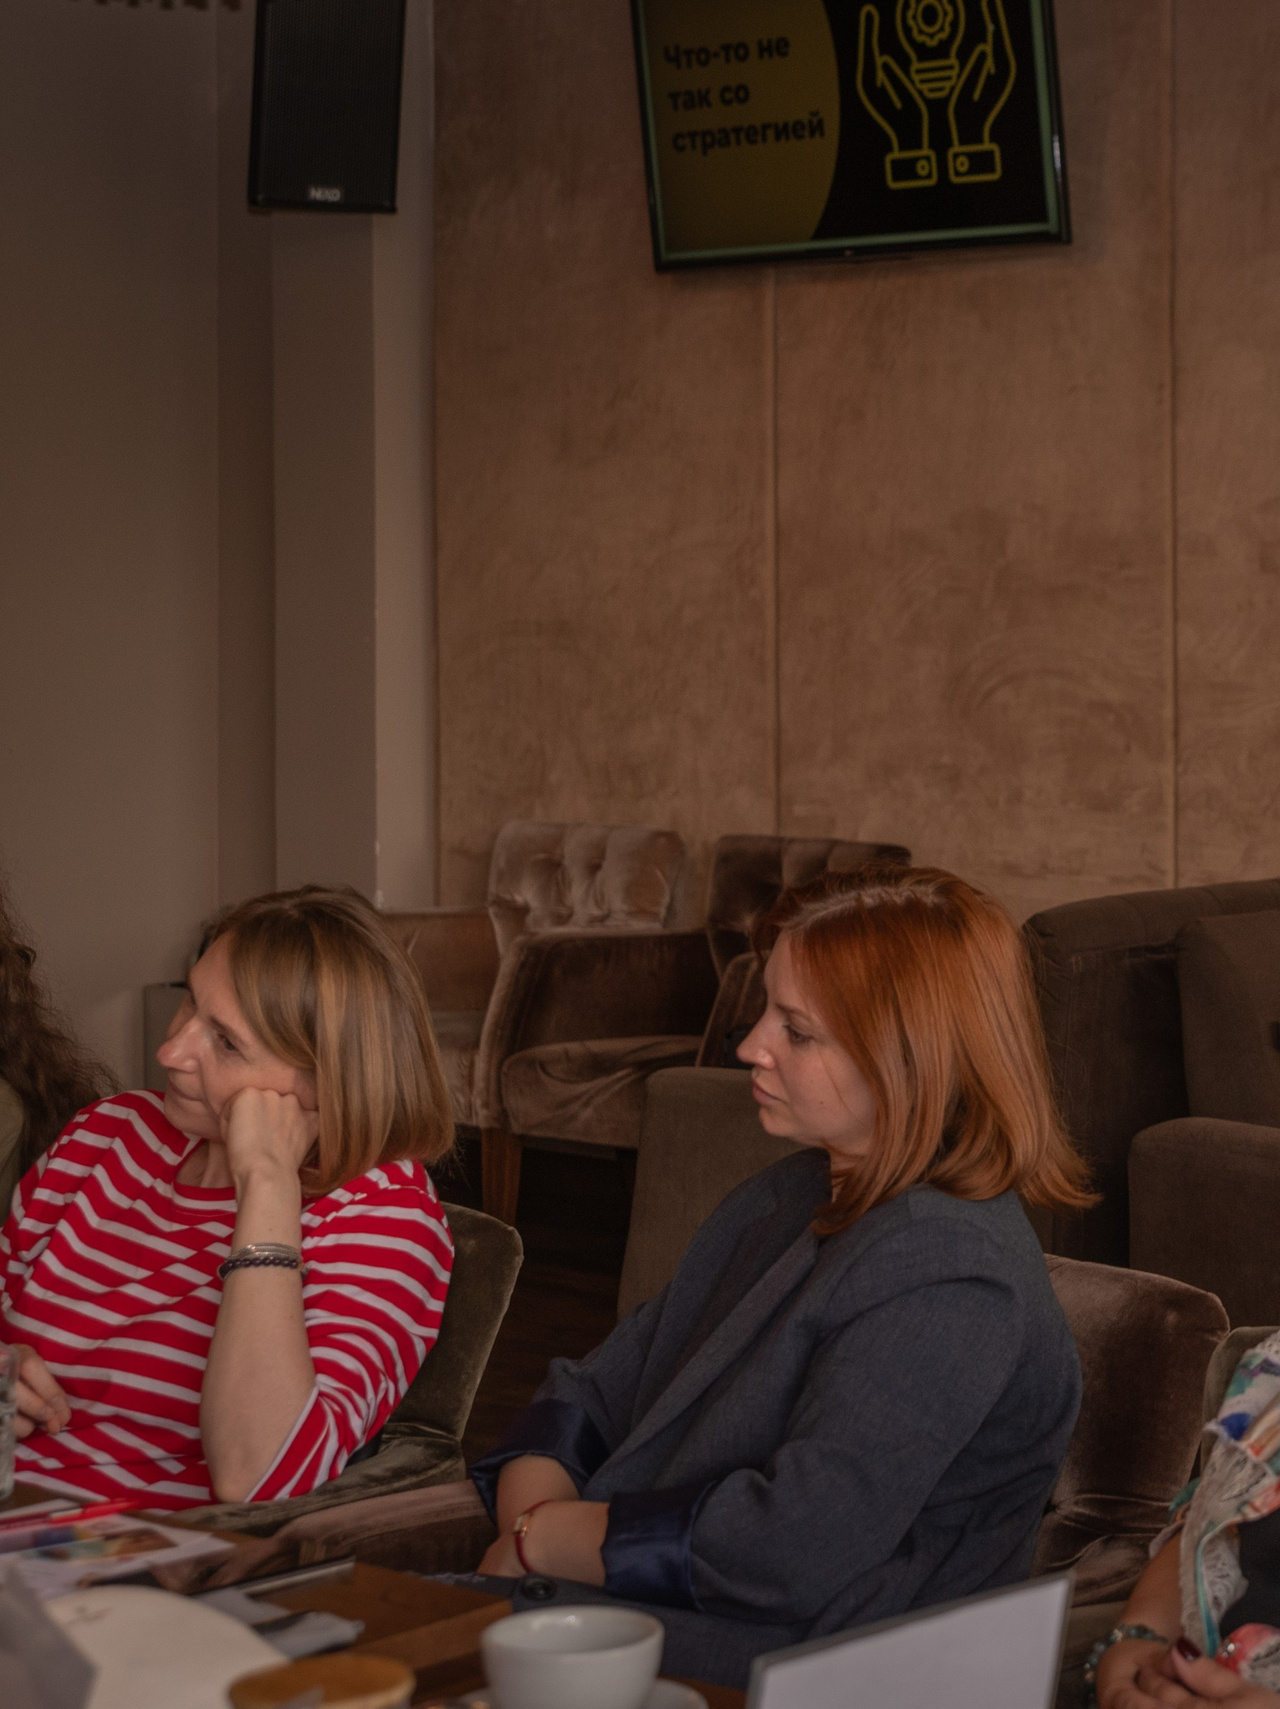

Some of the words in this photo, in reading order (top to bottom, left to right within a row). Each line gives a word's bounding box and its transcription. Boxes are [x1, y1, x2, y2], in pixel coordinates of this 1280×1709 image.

[663, 43, 749, 69] Что-то
[758, 37, 790, 59] не
[668, 89, 712, 110] так
[720, 84, 750, 105] со
[672, 111, 824, 156] стратегией
